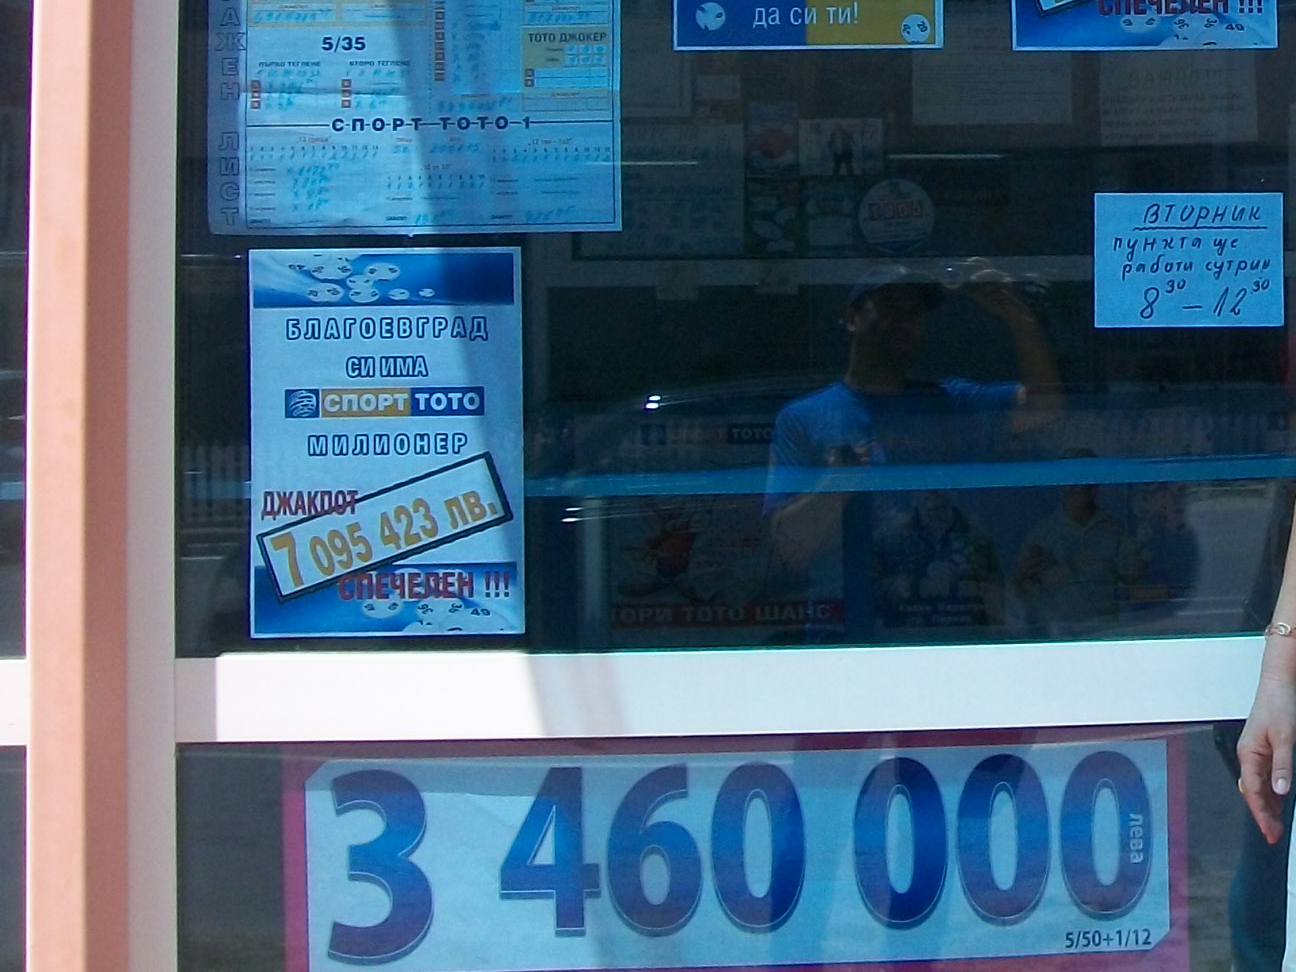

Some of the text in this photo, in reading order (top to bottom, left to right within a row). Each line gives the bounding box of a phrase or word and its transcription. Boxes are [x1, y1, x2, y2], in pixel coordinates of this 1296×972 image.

[753, 2, 859, 28] да си ти!
[322, 36, 366, 52] 5/35
[528, 33, 607, 43] ТОТО ДЖОКЕР
[331, 117, 422, 132] СПОРТ
[439, 116, 509, 130] ТОТО
[218, 131, 240, 226] ЛИСТ
[1143, 203, 1261, 227] ВТОРНИК
[1122, 254, 1271, 281] работи сутрин
[286, 315, 489, 341] БЛАГОЕВГРАД
[346, 355, 428, 378] СИ ИМА
[323, 392, 480, 412] СПОРТ ТОТО
[307, 433, 467, 456] МИЛИОНЕР
[261, 489, 358, 520] ДЖАКПОТ
[271, 531, 306, 588] 7
[309, 521, 374, 577] 095
[380, 497, 439, 551] 423
[337, 571, 510, 601] СПЕЧЕЛЕН !!!
[682, 605, 745, 621] ТОТО
[755, 603, 832, 620] ШАНС
[326, 750, 1152, 966] 3 460 000
[1064, 927, 1153, 950] 5/50+1/12
